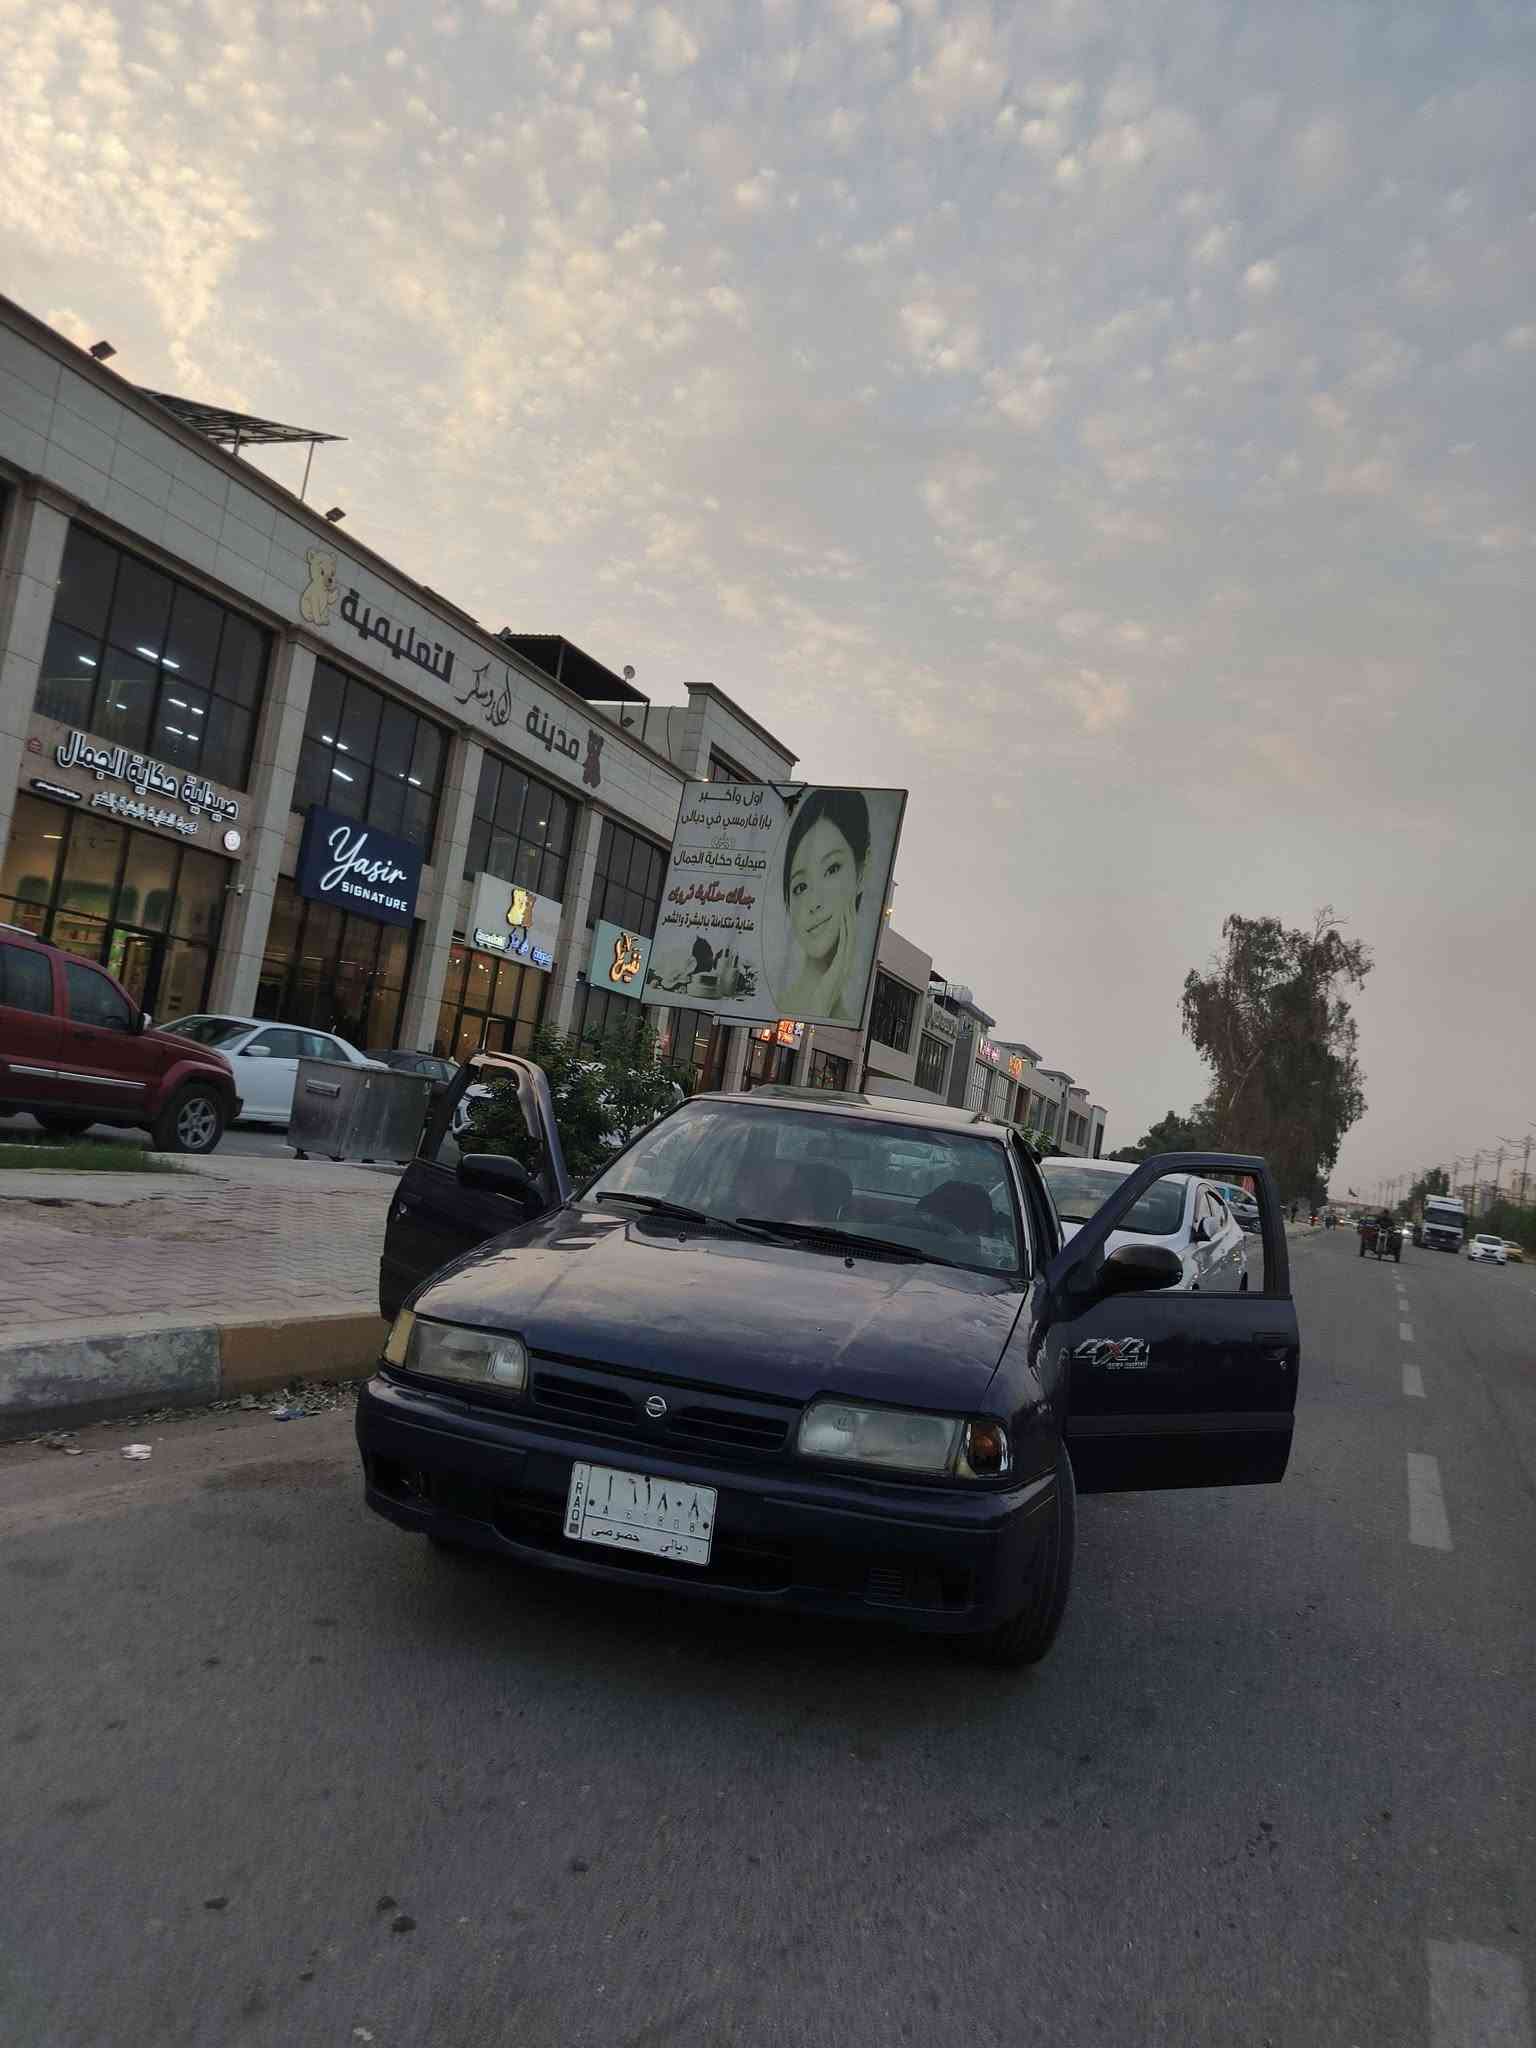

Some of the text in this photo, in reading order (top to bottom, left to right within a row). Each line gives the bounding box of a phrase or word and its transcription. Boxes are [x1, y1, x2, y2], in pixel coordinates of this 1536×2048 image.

[340, 587, 456, 684] التعليمية
[56, 730, 129, 781] الجمال
[526, 704, 580, 761] مدينة
[126, 754, 180, 800] حكاية
[180, 774, 240, 822] صيدلية
[706, 812, 722, 830] في
[319, 825, 409, 892] Yasir
[673, 849, 767, 872] صيدلية حكاية الجمال
[341, 880, 409, 913] SIGNATURE
